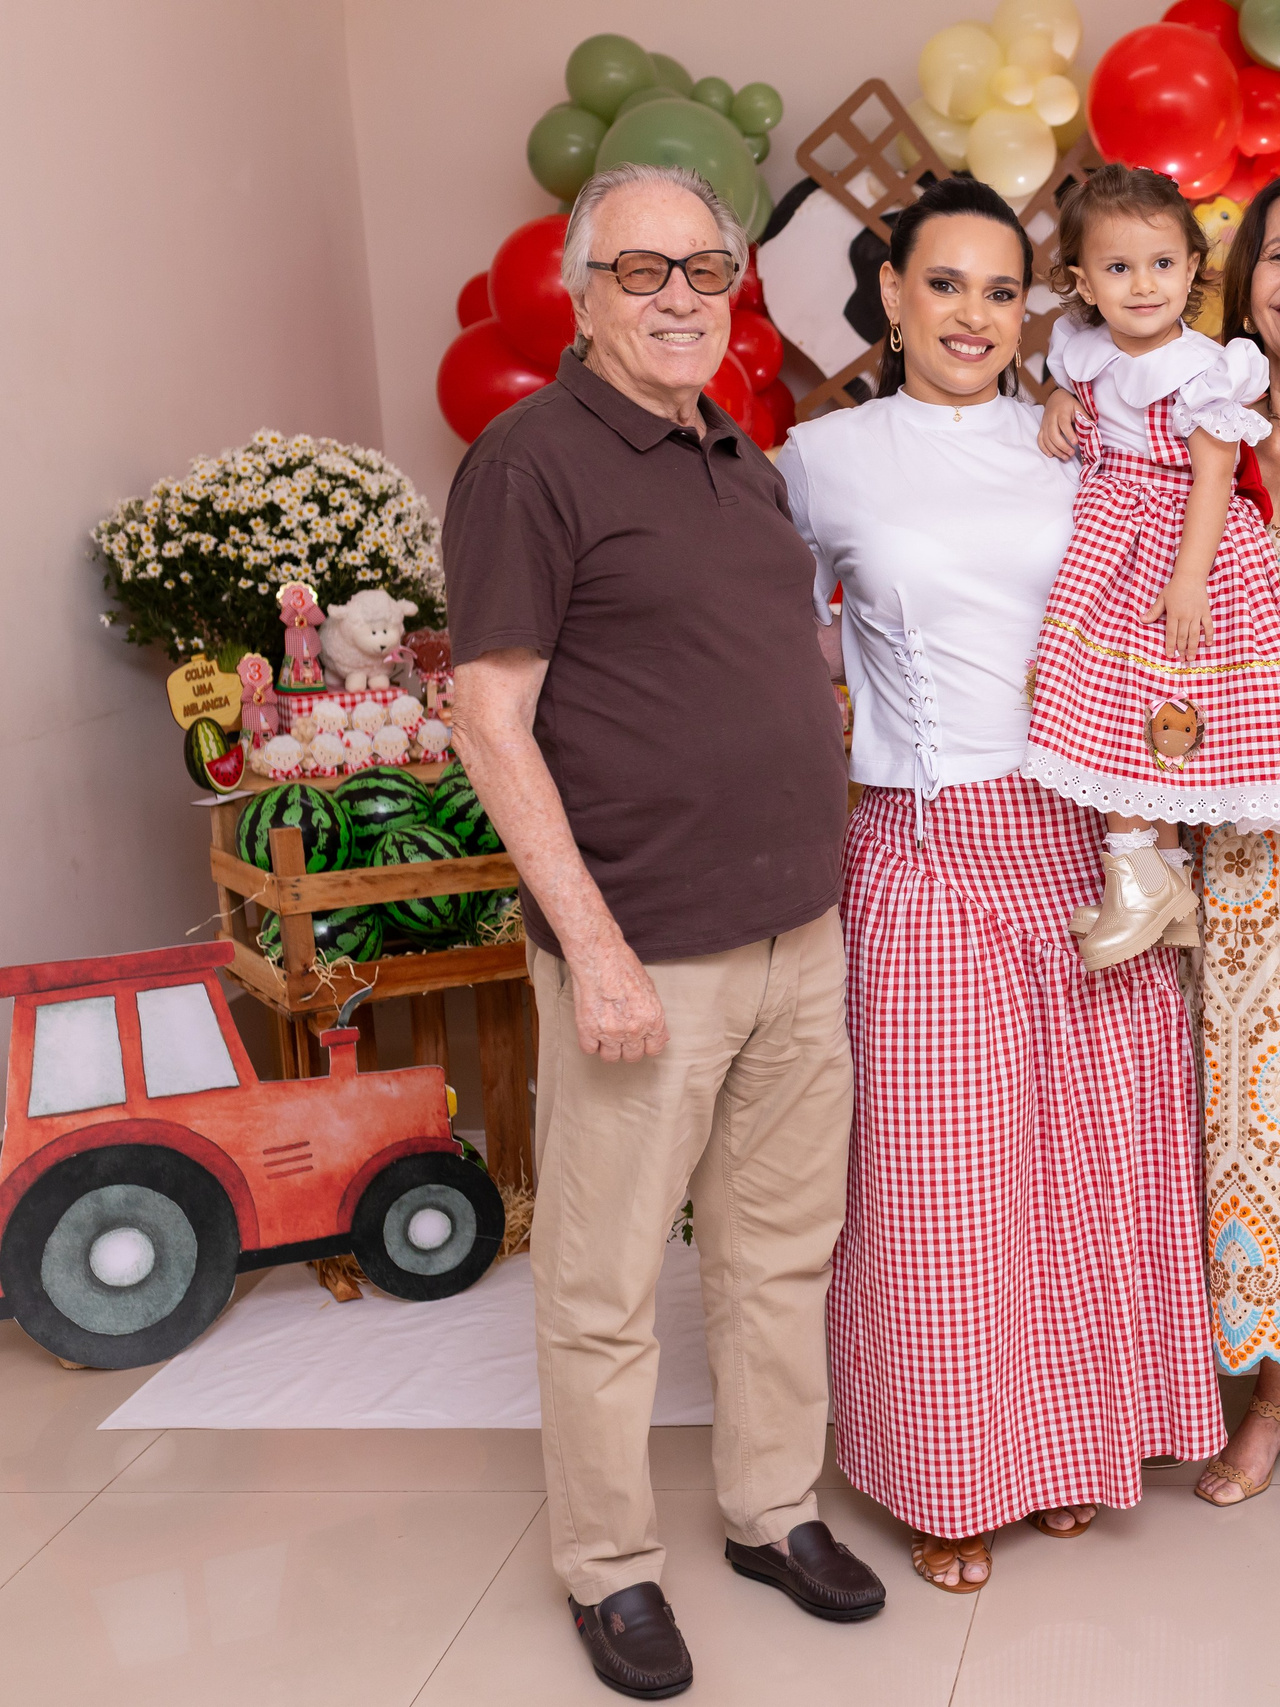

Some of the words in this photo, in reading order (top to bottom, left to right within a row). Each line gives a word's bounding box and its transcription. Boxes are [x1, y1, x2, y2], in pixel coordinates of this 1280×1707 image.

[291, 589, 305, 609] 3
[185, 664, 215, 682] COLHA
[247, 662, 262, 681] 3
[192, 682, 214, 697] UMA
[183, 695, 230, 718] MELANCIA
